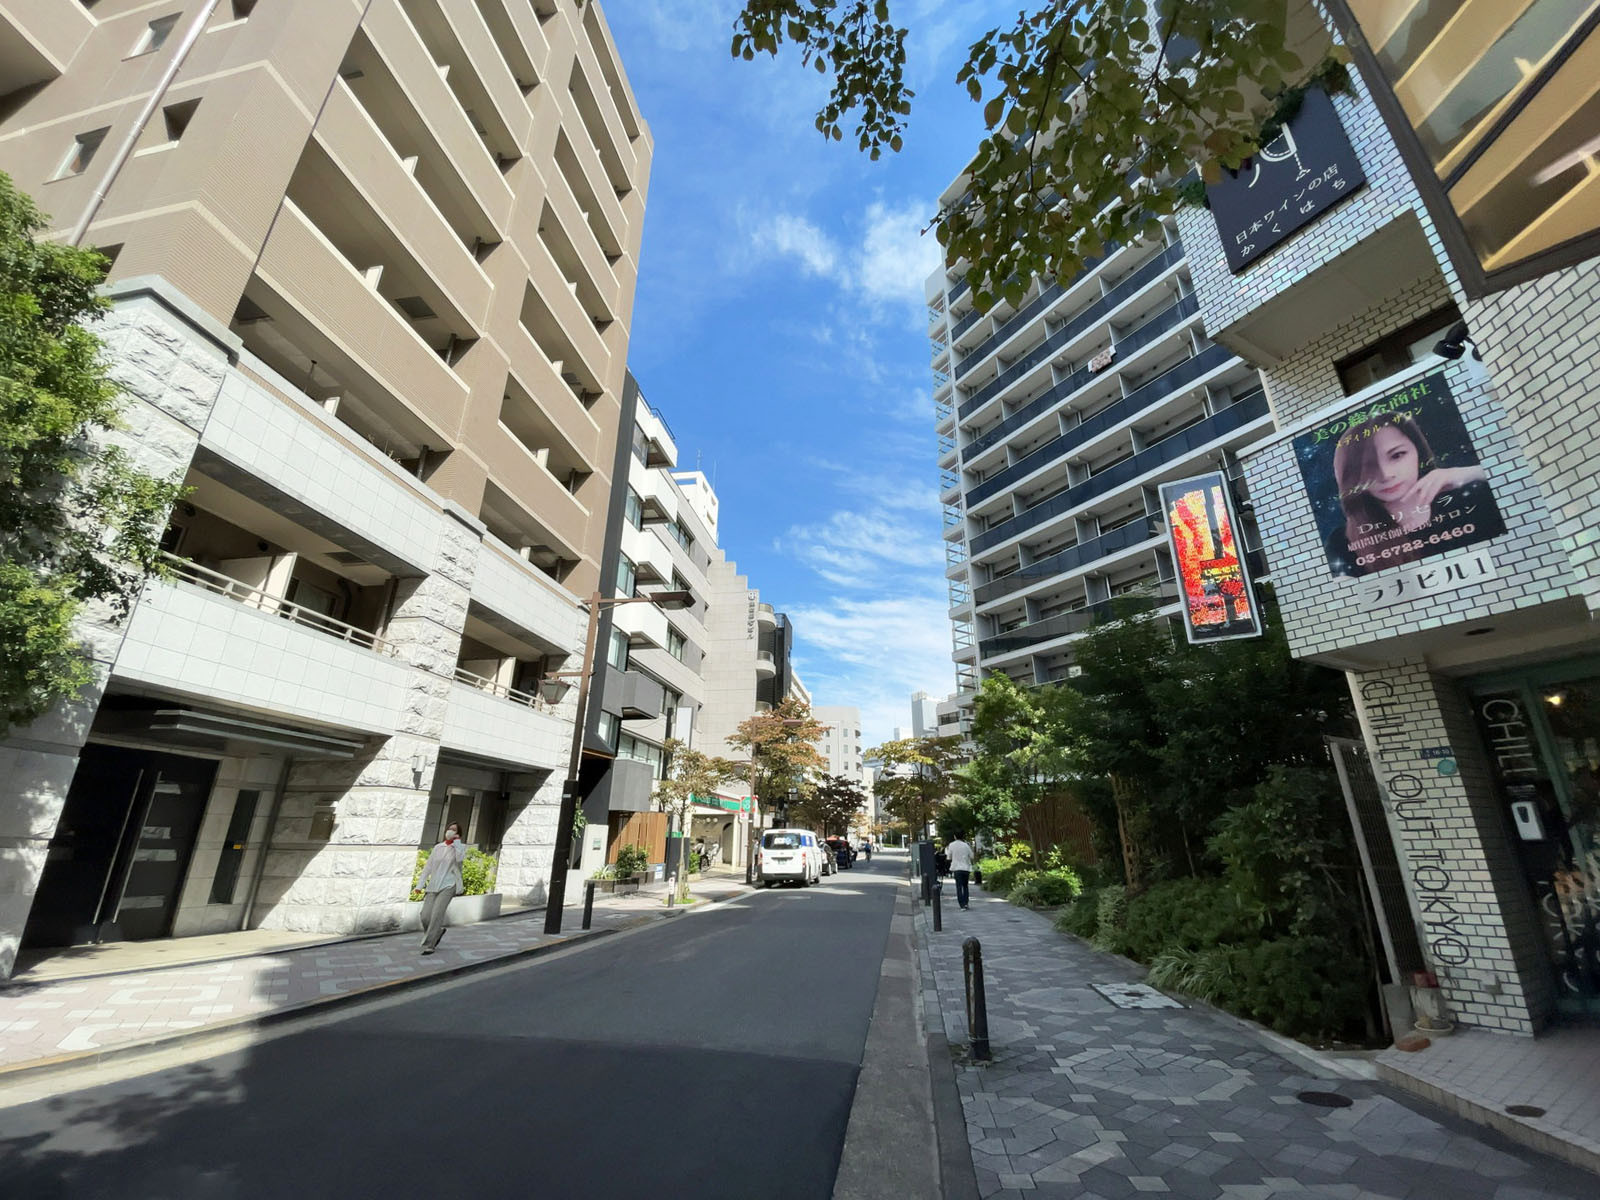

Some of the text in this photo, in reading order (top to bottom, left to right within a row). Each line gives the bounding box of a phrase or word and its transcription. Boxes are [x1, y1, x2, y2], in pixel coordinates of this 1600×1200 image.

[1236, 163, 1339, 245] 日本ワインの店
[1240, 178, 1346, 257] かくはち
[1355, 523, 1476, 566] 03-6722-6460
[1357, 522, 1388, 535] Dr.
[1482, 699, 1537, 776] CHILL
[1362, 681, 1470, 965] CHILL OUT TOKYO
